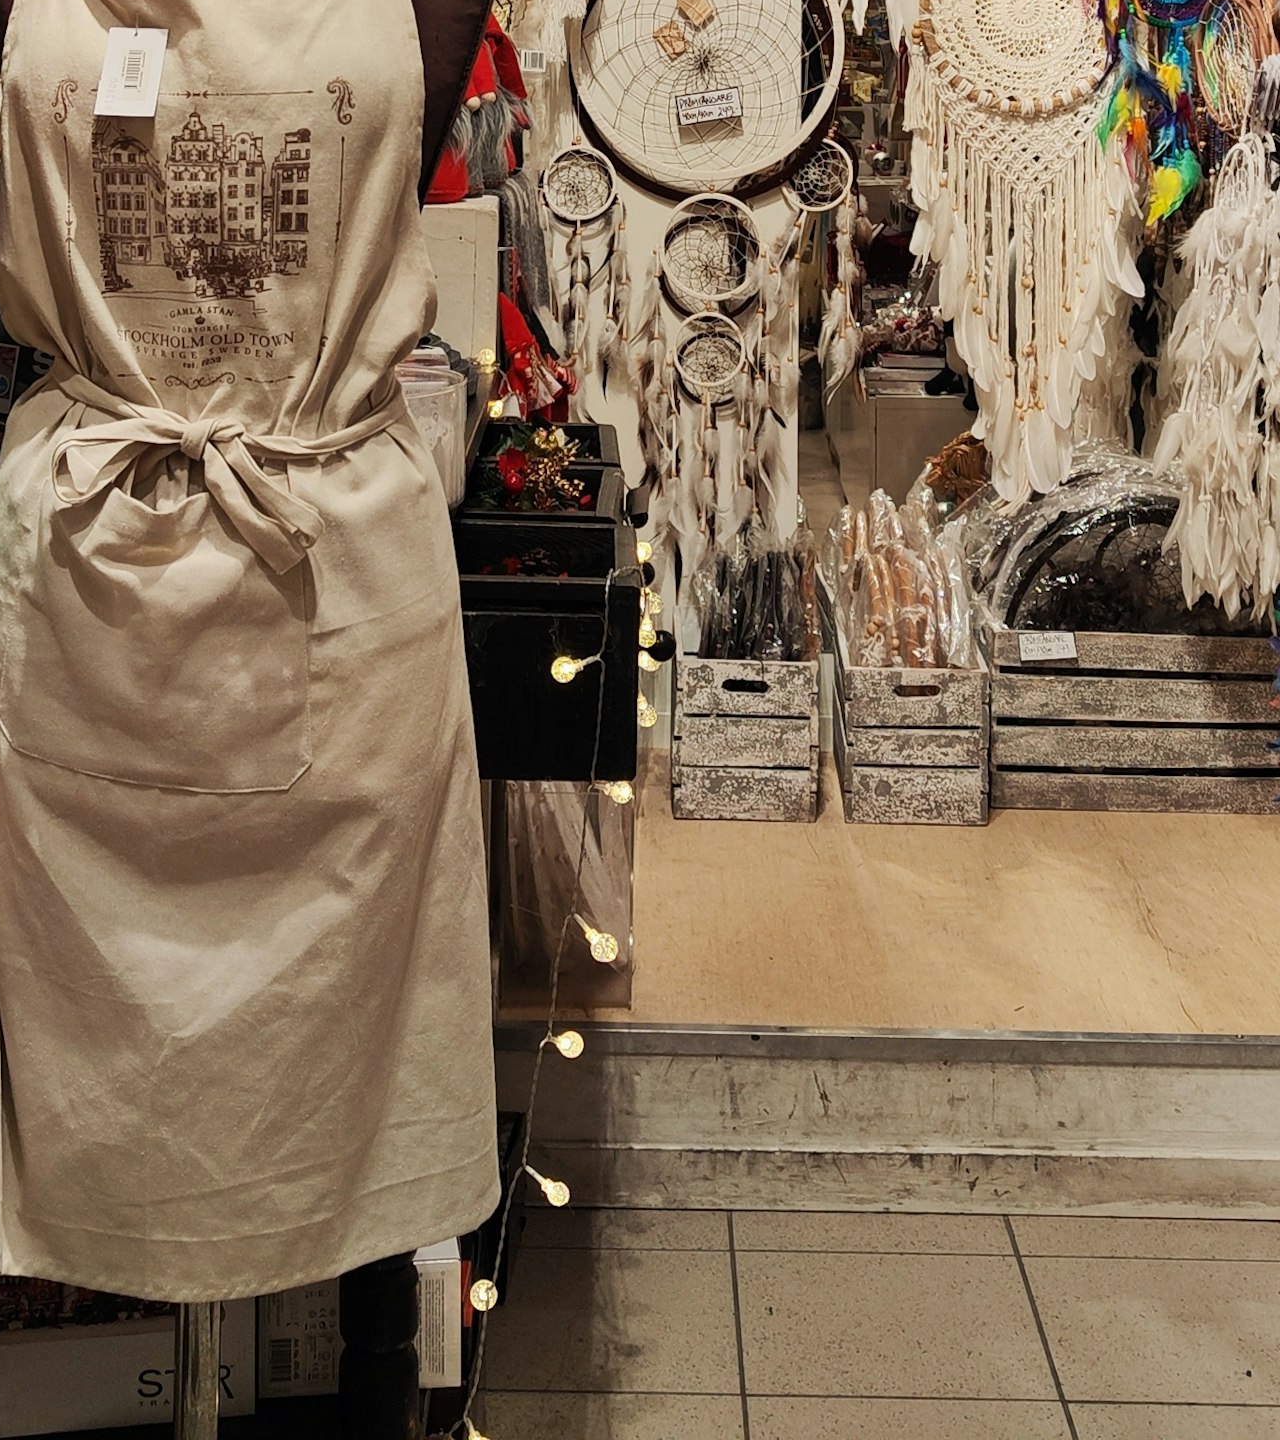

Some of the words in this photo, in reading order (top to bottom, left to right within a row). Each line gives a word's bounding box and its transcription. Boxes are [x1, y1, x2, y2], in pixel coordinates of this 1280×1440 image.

[207, 305, 235, 317] STAN
[116, 328, 206, 350] STOCKHOLM
[210, 332, 245, 347] OLD
[248, 331, 297, 349] TOWN
[135, 345, 199, 360] SVERIGE
[208, 345, 274, 359] SWEDEN
